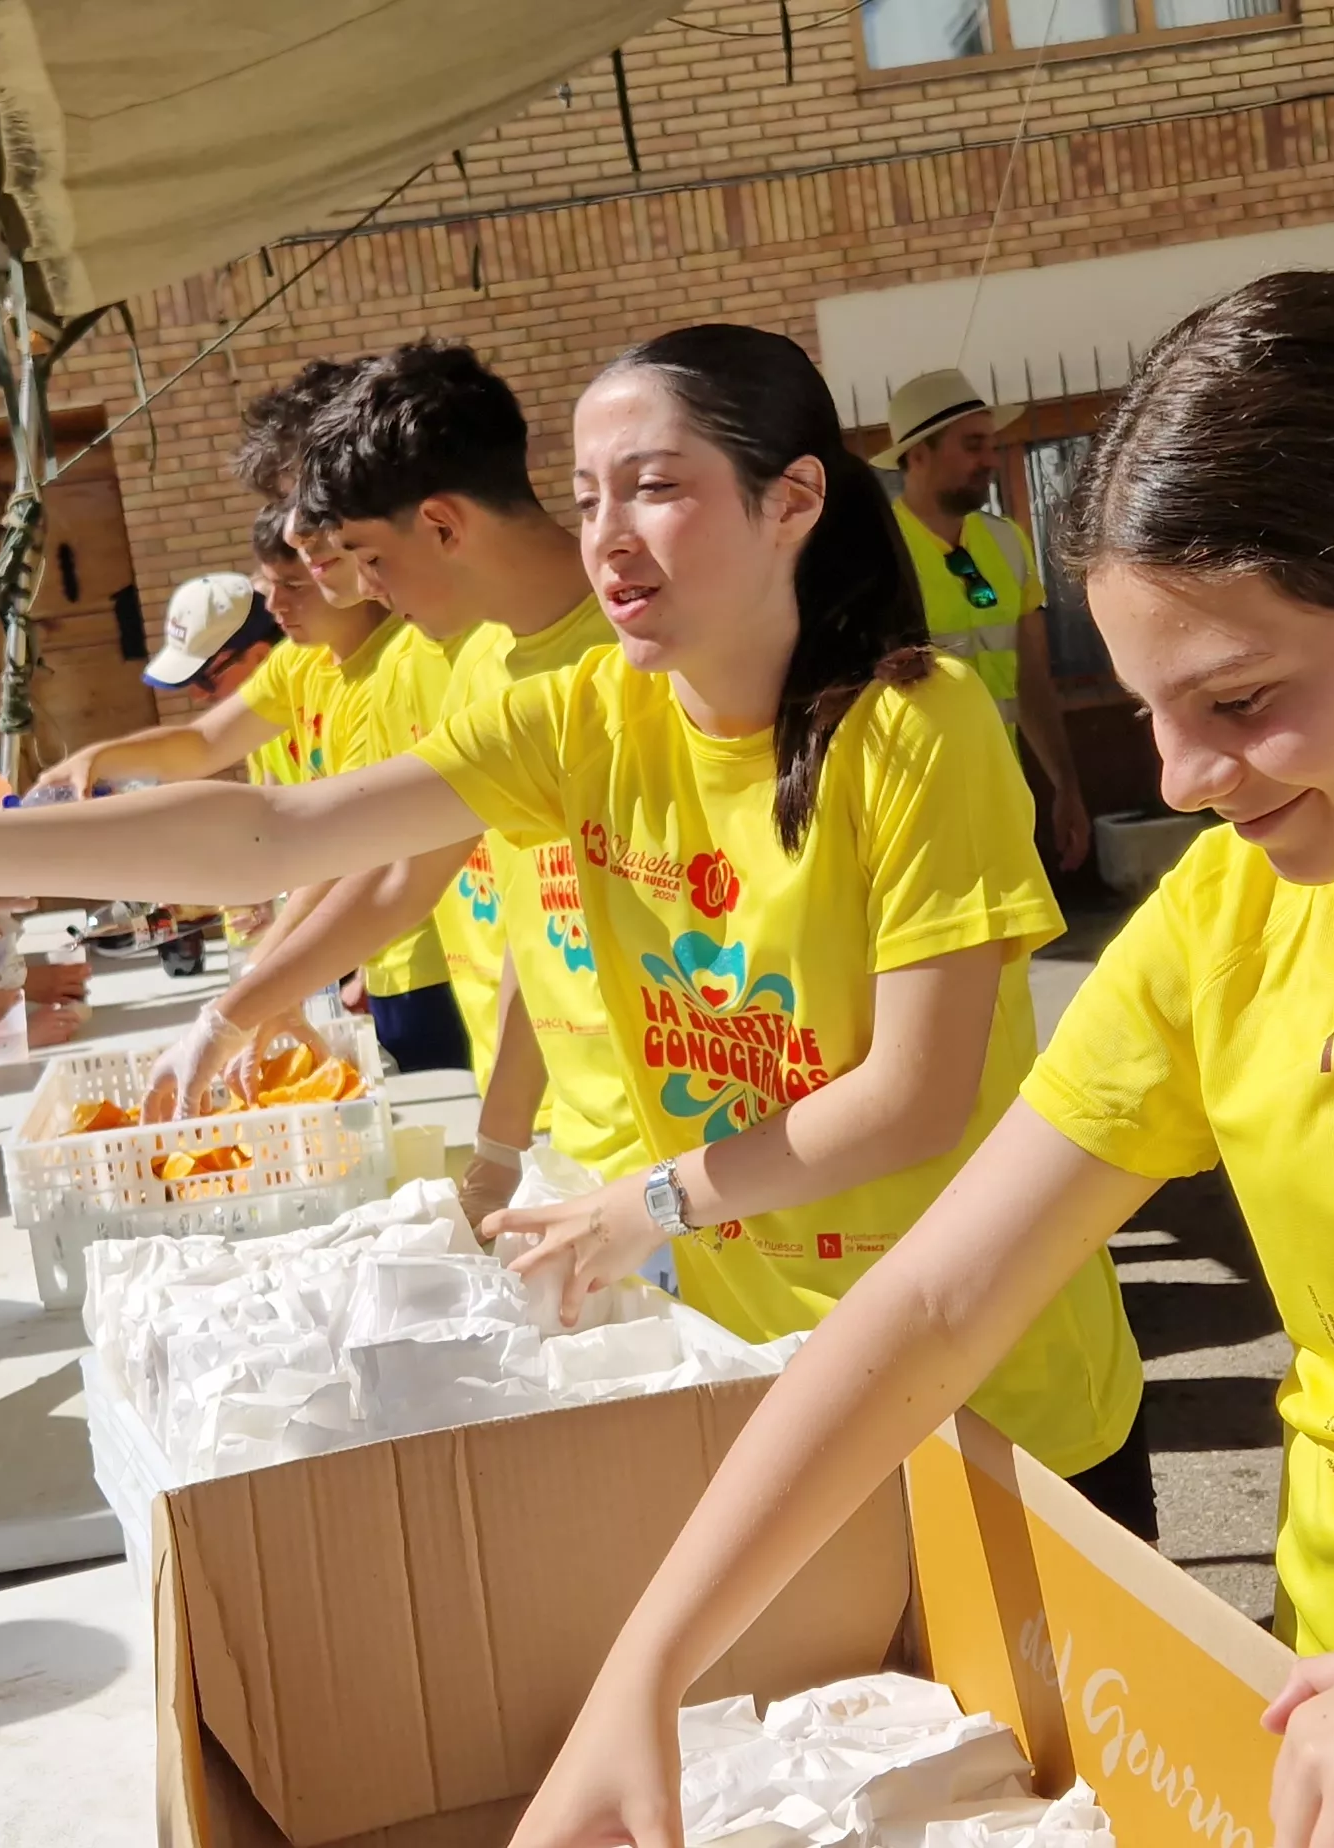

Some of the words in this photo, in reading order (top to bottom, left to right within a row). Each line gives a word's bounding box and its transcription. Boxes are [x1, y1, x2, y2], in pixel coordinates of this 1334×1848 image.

[581, 820, 607, 867] 13
[609, 833, 684, 879] Marcha
[642, 873, 680, 892] HUESCA
[652, 889, 677, 903] 2025
[641, 985, 682, 1027] LA
[787, 1024, 823, 1066] DE
[644, 1025, 829, 1105] CONOCERNOS
